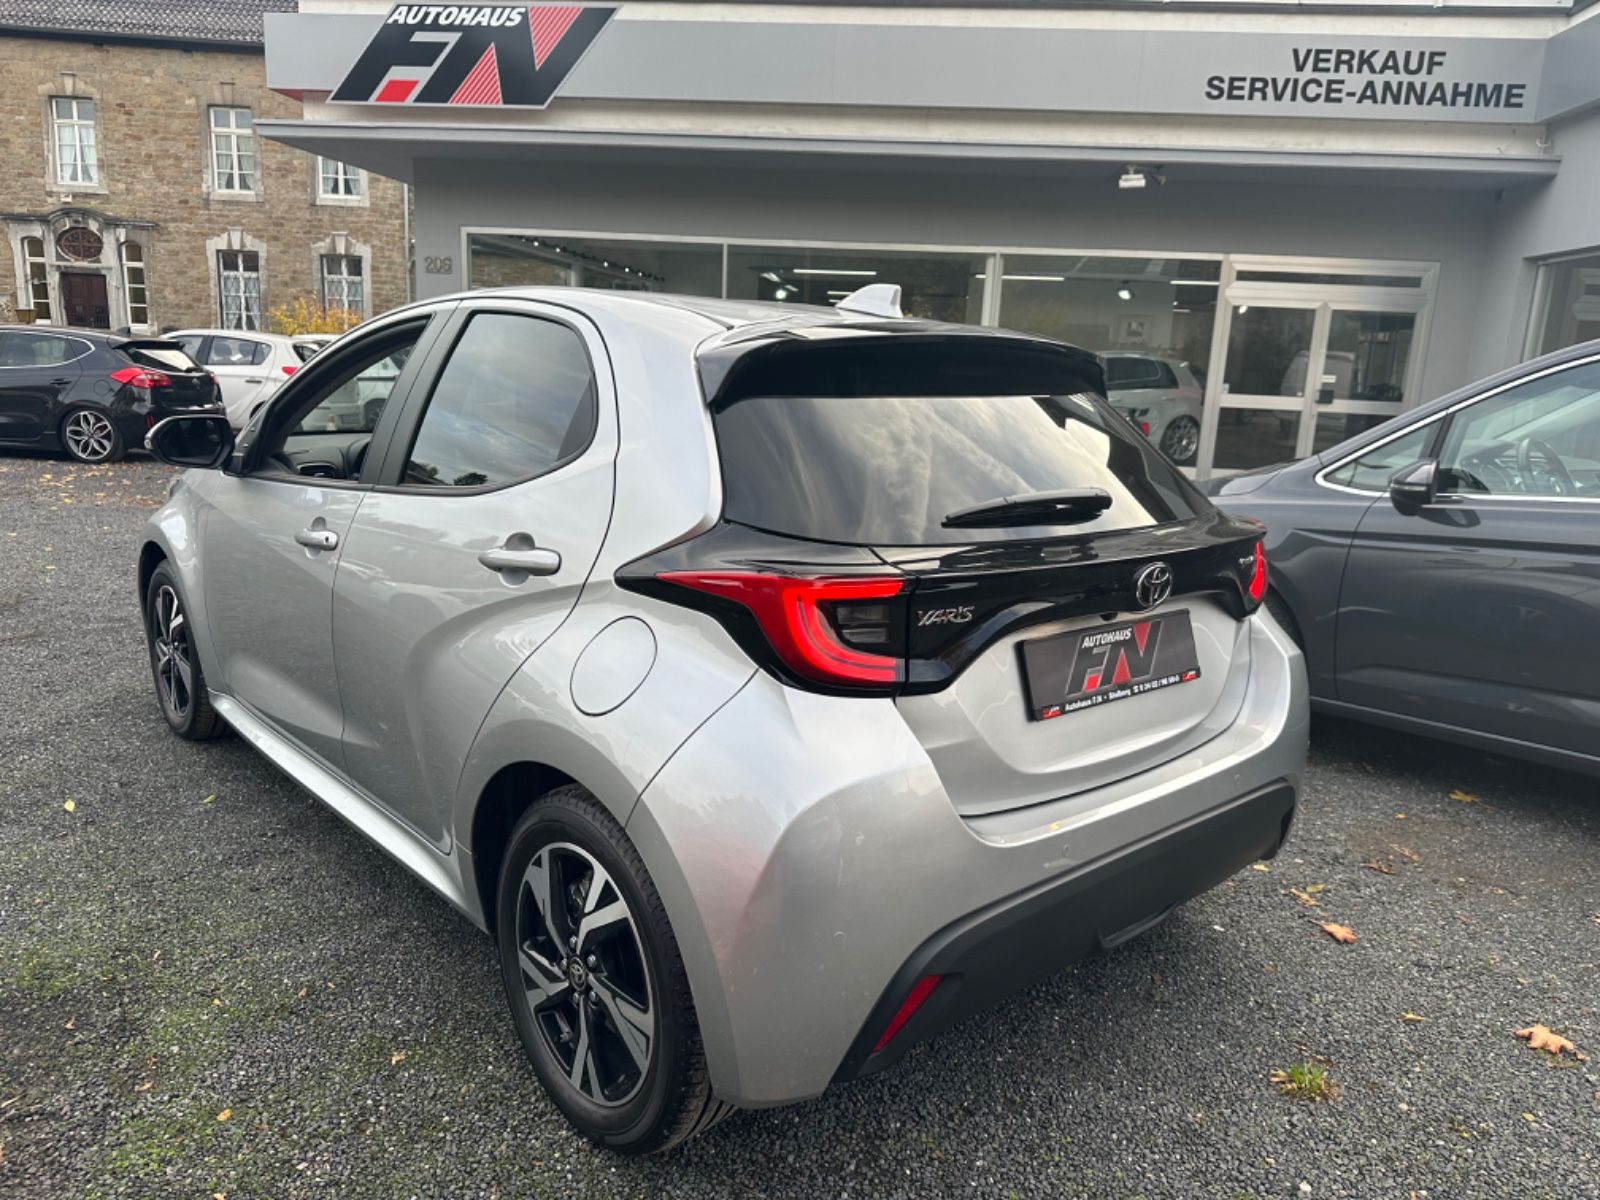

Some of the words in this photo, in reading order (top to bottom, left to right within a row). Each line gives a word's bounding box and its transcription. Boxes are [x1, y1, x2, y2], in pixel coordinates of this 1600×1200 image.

[387, 5, 526, 27] AUTOHAUS
[1291, 48, 1447, 75] VERKAUF
[1204, 75, 1527, 108] SERVICE-ANNAHME
[917, 606, 975, 626] YARIS
[1081, 628, 1133, 649] AUTOHAUS
